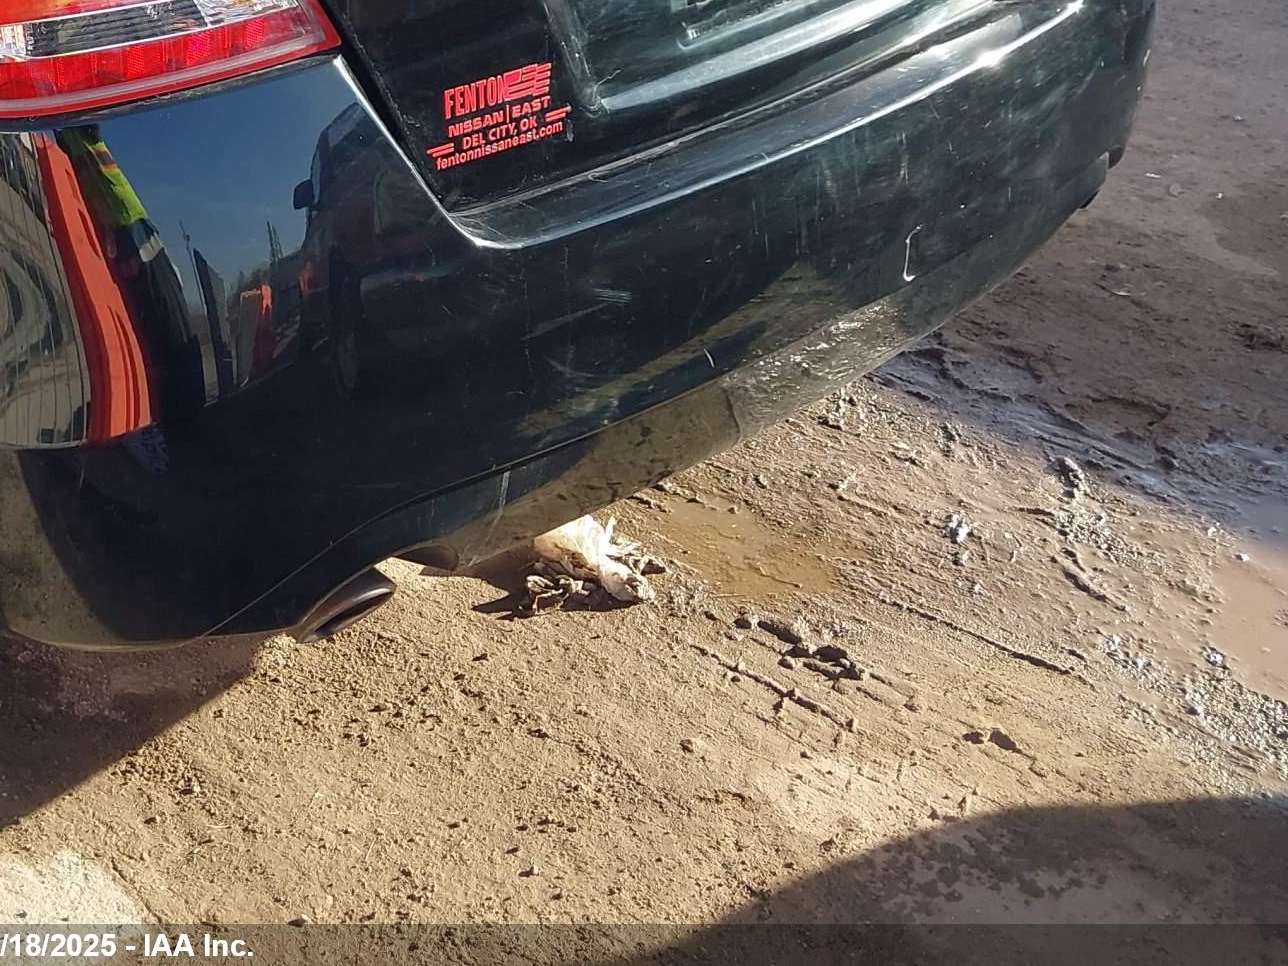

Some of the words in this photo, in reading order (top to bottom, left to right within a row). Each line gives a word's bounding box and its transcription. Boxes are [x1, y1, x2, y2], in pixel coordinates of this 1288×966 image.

[444, 75, 512, 119] FENTON
[448, 110, 504, 138] NISSAN
[512, 96, 551, 118] EAST
[436, 121, 564, 171] fentonnissaneast.com
[463, 135, 486, 150] DEL
[488, 122, 517, 142] CITY,
[520, 115, 538, 132] OK
